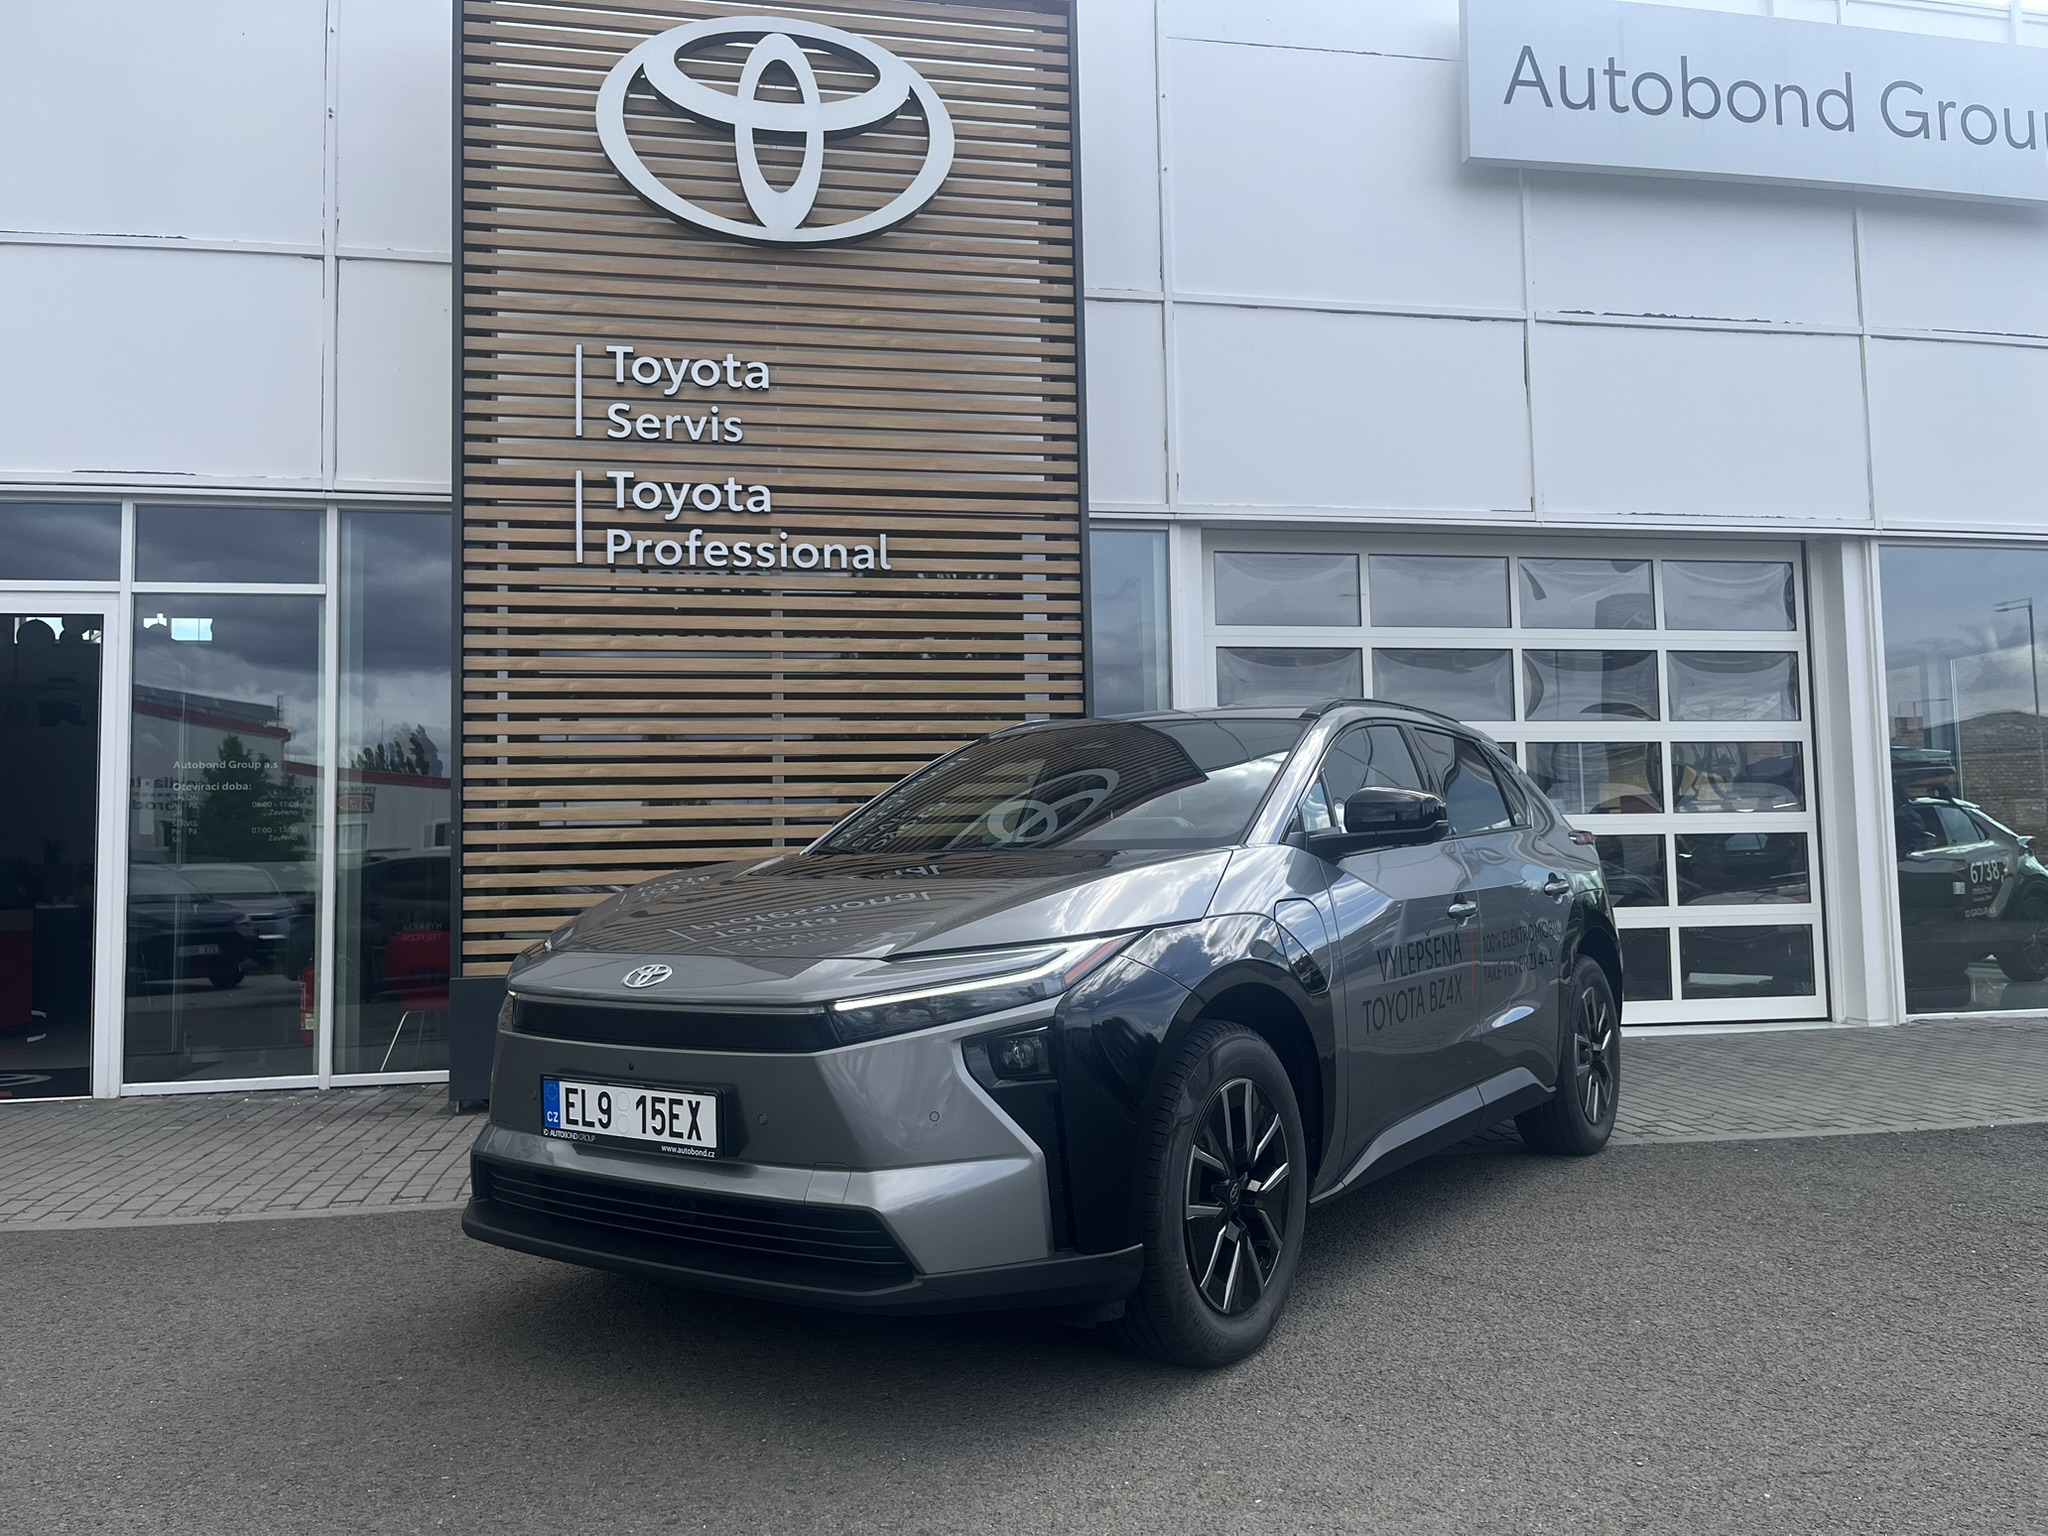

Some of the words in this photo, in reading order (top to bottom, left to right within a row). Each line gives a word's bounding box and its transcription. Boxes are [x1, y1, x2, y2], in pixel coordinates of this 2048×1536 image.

[1503, 44, 1855, 133] Autobond
[1880, 80, 2048, 151] Grou
[605, 345, 770, 396] Toyota
[606, 402, 744, 443] Servis
[605, 470, 772, 521] Toyota
[606, 528, 892, 571] Professional
[173, 760, 226, 769] Autobond
[228, 760, 262, 771] Group
[221, 782, 252, 791] doba:
[1377, 924, 1463, 982] VYLEPŠENÁ
[1363, 984, 1426, 1035] TOYOTA
[1429, 972, 1463, 1013] BZ4X
[547, 1110, 559, 1123] CZ
[565, 1087, 612, 1129] EL9
[635, 1095, 702, 1141] 15EX
[550, 1130, 578, 1140] AUTOBOND
[579, 1134, 596, 1142] GROUP
[661, 1144, 715, 1158] www.autobond.cz
